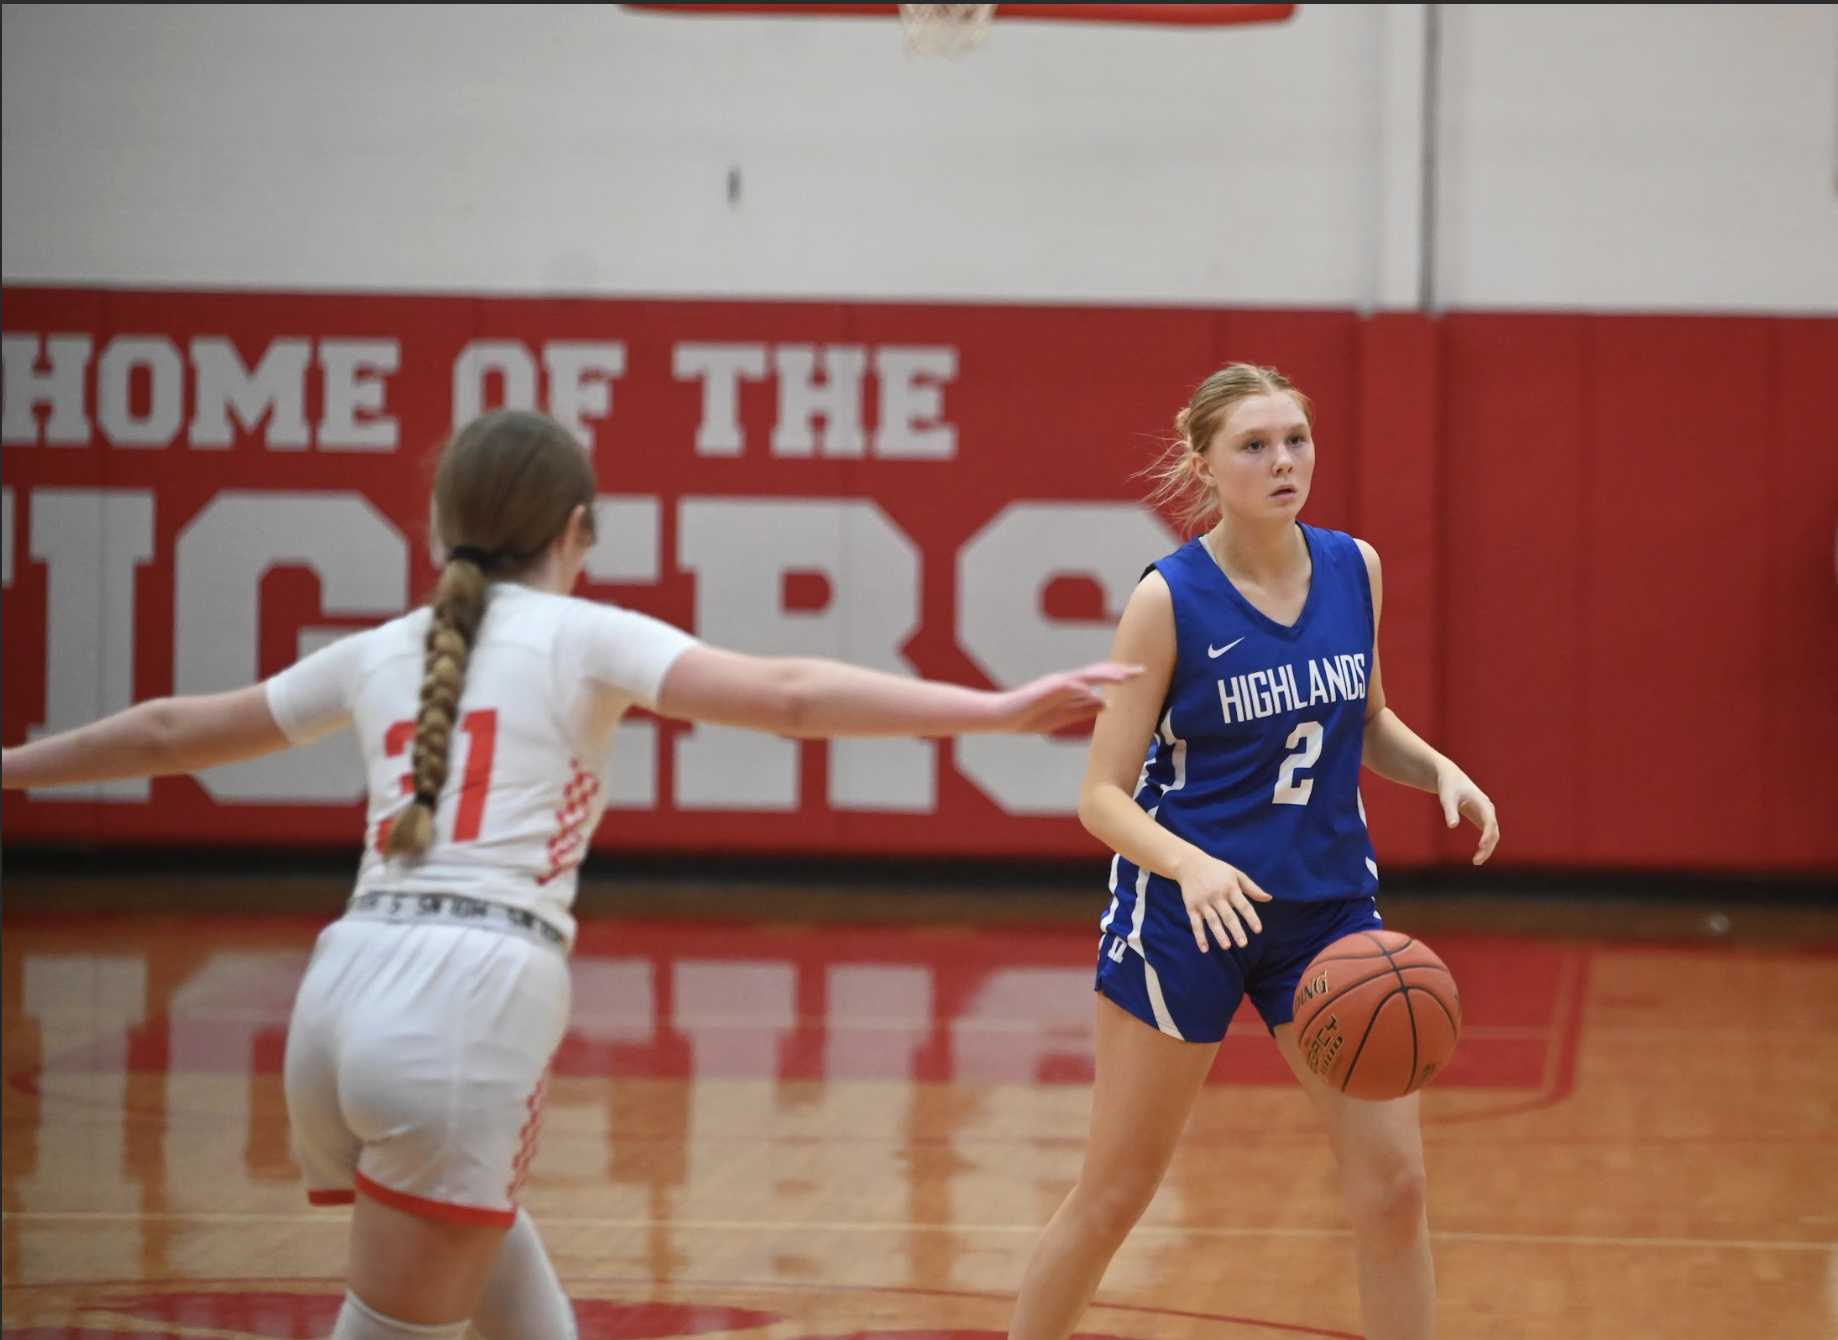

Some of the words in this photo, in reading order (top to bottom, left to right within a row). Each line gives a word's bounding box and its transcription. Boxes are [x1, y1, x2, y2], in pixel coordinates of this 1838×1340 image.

[2, 332, 400, 452] HOME
[452, 339, 626, 450] OF
[672, 341, 960, 460] THE
[2, 485, 1182, 816] IGRS
[1217, 653, 1366, 724] HIGHLANDS
[1272, 720, 1324, 806] 2
